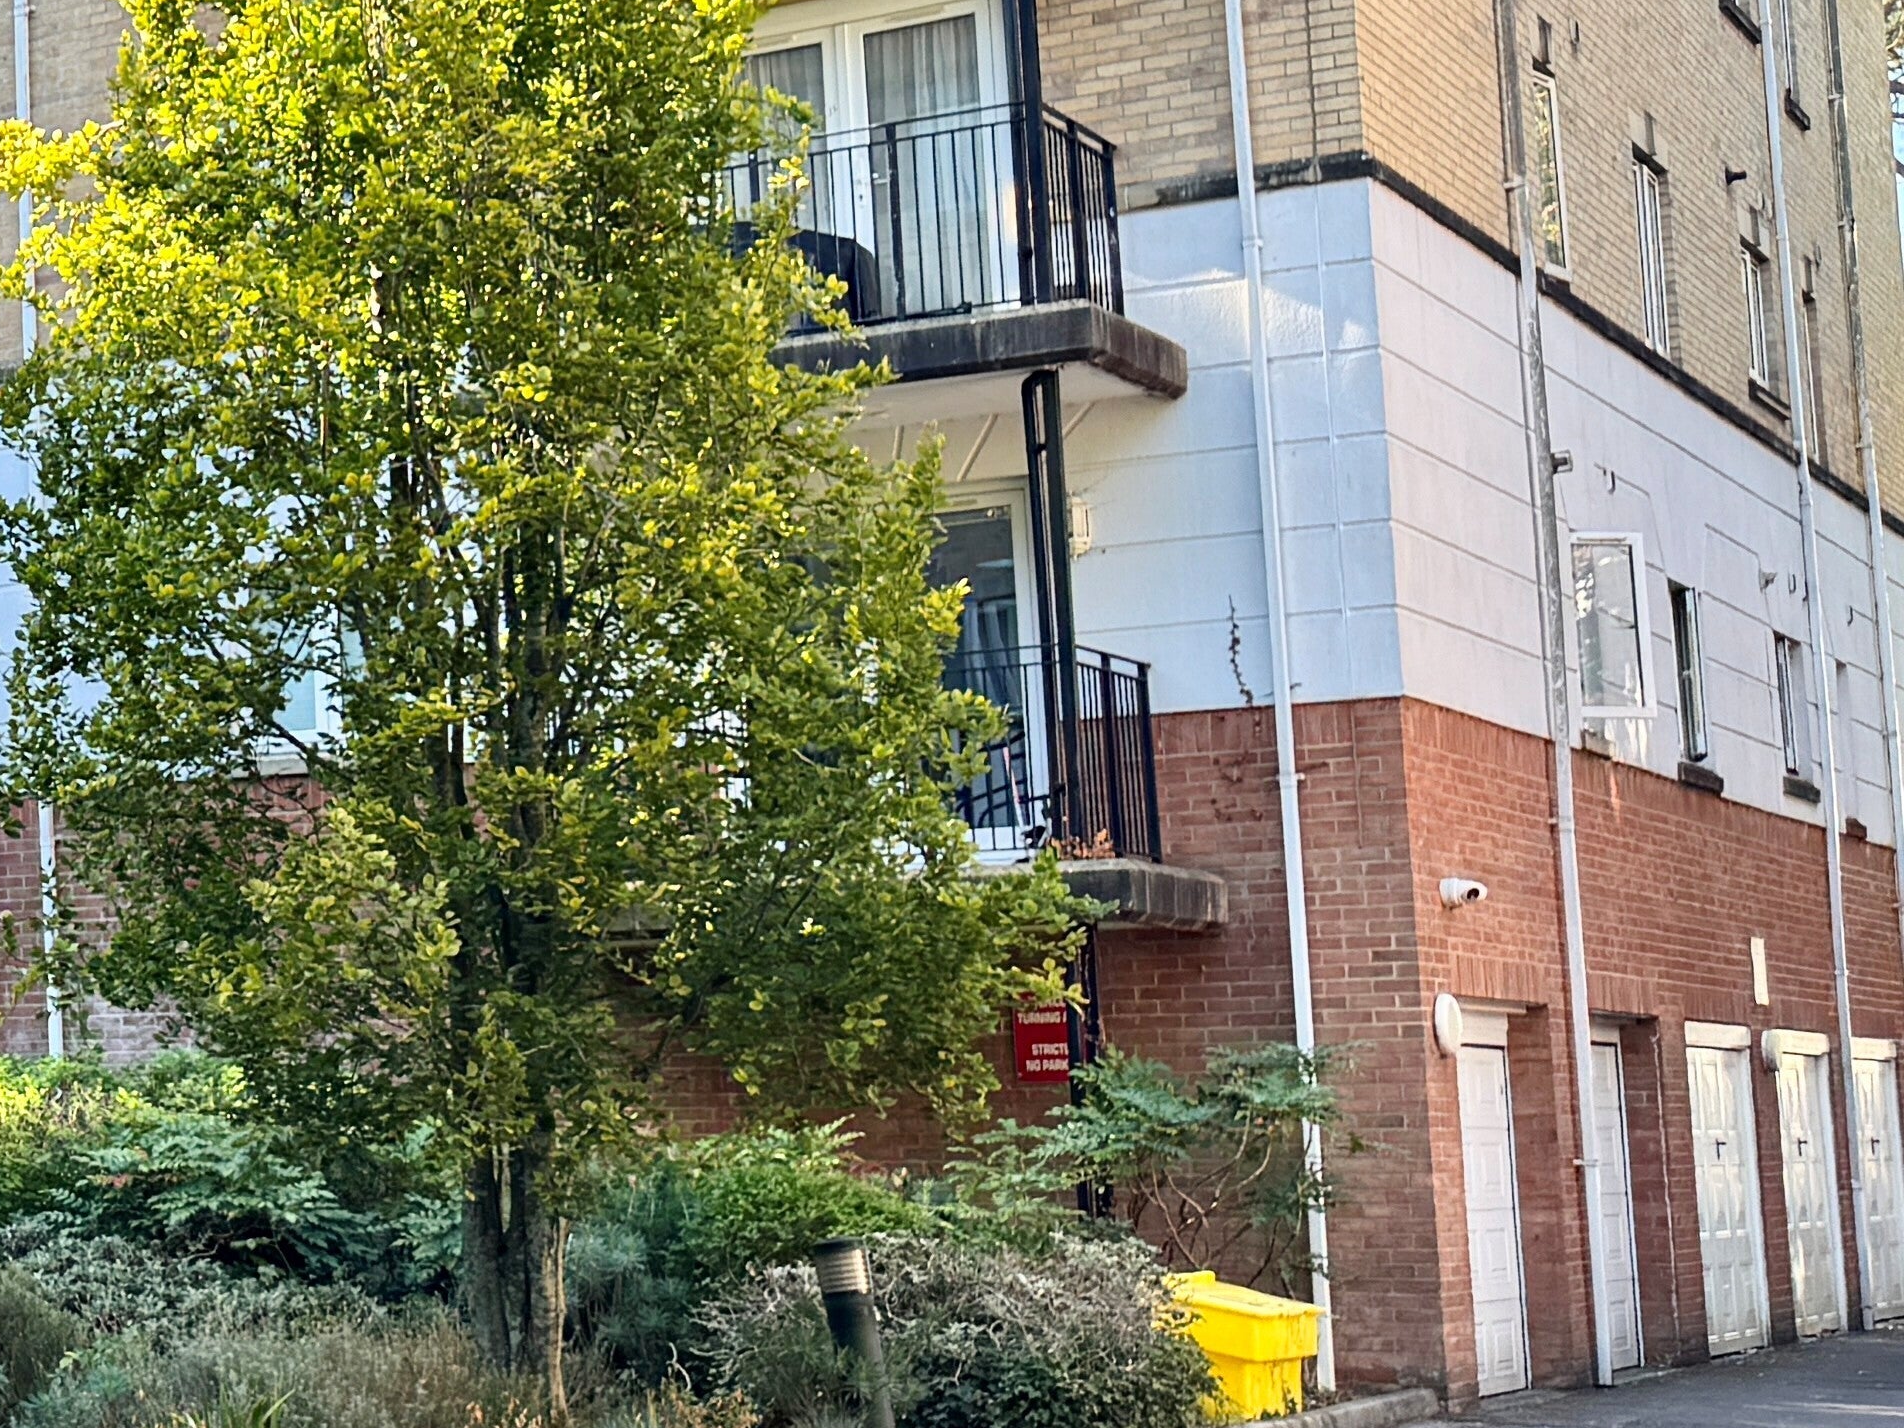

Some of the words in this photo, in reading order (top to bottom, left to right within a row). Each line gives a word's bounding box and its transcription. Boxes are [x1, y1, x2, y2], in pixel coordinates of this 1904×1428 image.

[1017, 1011, 1061, 1024] TURNING
[1031, 1042, 1069, 1056] STRICTL
[1025, 1059, 1042, 1072] NO
[1042, 1058, 1069, 1071] PARK
